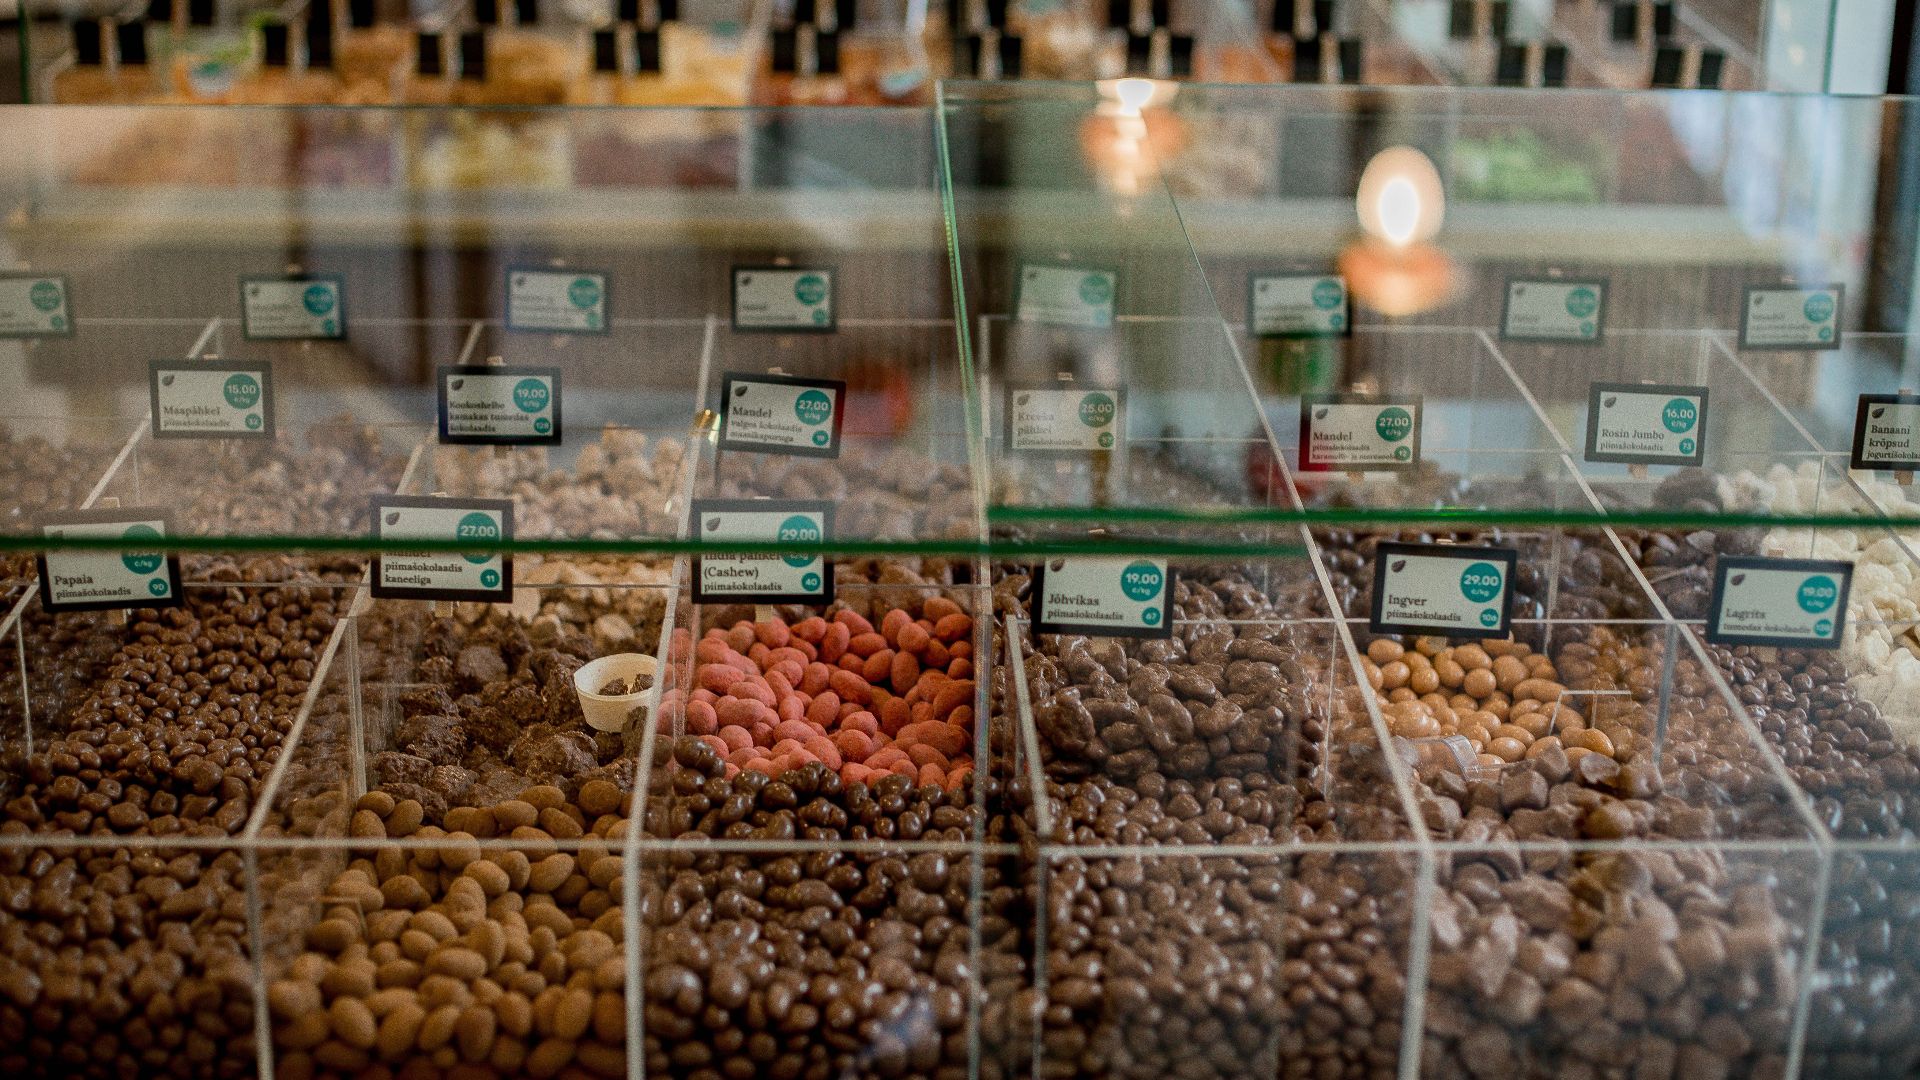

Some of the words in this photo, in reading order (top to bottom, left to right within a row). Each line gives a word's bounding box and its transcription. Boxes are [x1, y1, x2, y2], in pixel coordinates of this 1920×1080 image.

[227, 384, 257, 394] 15.00
[518, 389, 547, 399] 19.00
[163, 406, 220, 416] Maapähkel
[799, 401, 828, 411] 27.00
[732, 407, 772, 418] Mandel
[1666, 409, 1694, 419] 16.00
[1379, 417, 1409, 427] 27.00
[1601, 428, 1630, 438] Rosin
[1632, 430, 1665, 440] Jumbo
[1871, 425, 1911, 435] Banaani
[1313, 431, 1352, 441] Mandel
[1600, 441, 1663, 451] piimašokolaadis
[461, 525, 496, 537] 27.00
[781, 529, 818, 541] 29.00
[385, 562, 463, 573] piimašokolaadis
[703, 566, 759, 580] (Cashew)
[54, 574, 94, 587] Papaia
[385, 574, 432, 586] kaneeliga
[1125, 573, 1159, 584] 19.00
[1463, 574, 1500, 587] 29.00
[152, 583, 164, 591] 90
[704, 582, 782, 593] piimašokolaadis
[56, 587, 132, 600] piimašokolaadis
[1388, 594, 1428, 608] Ingver
[1047, 608, 1124, 621] piimašokolaadis
[1386, 609, 1462, 621] piimašokolaadis
[1725, 608, 1766, 621] Lagrits
